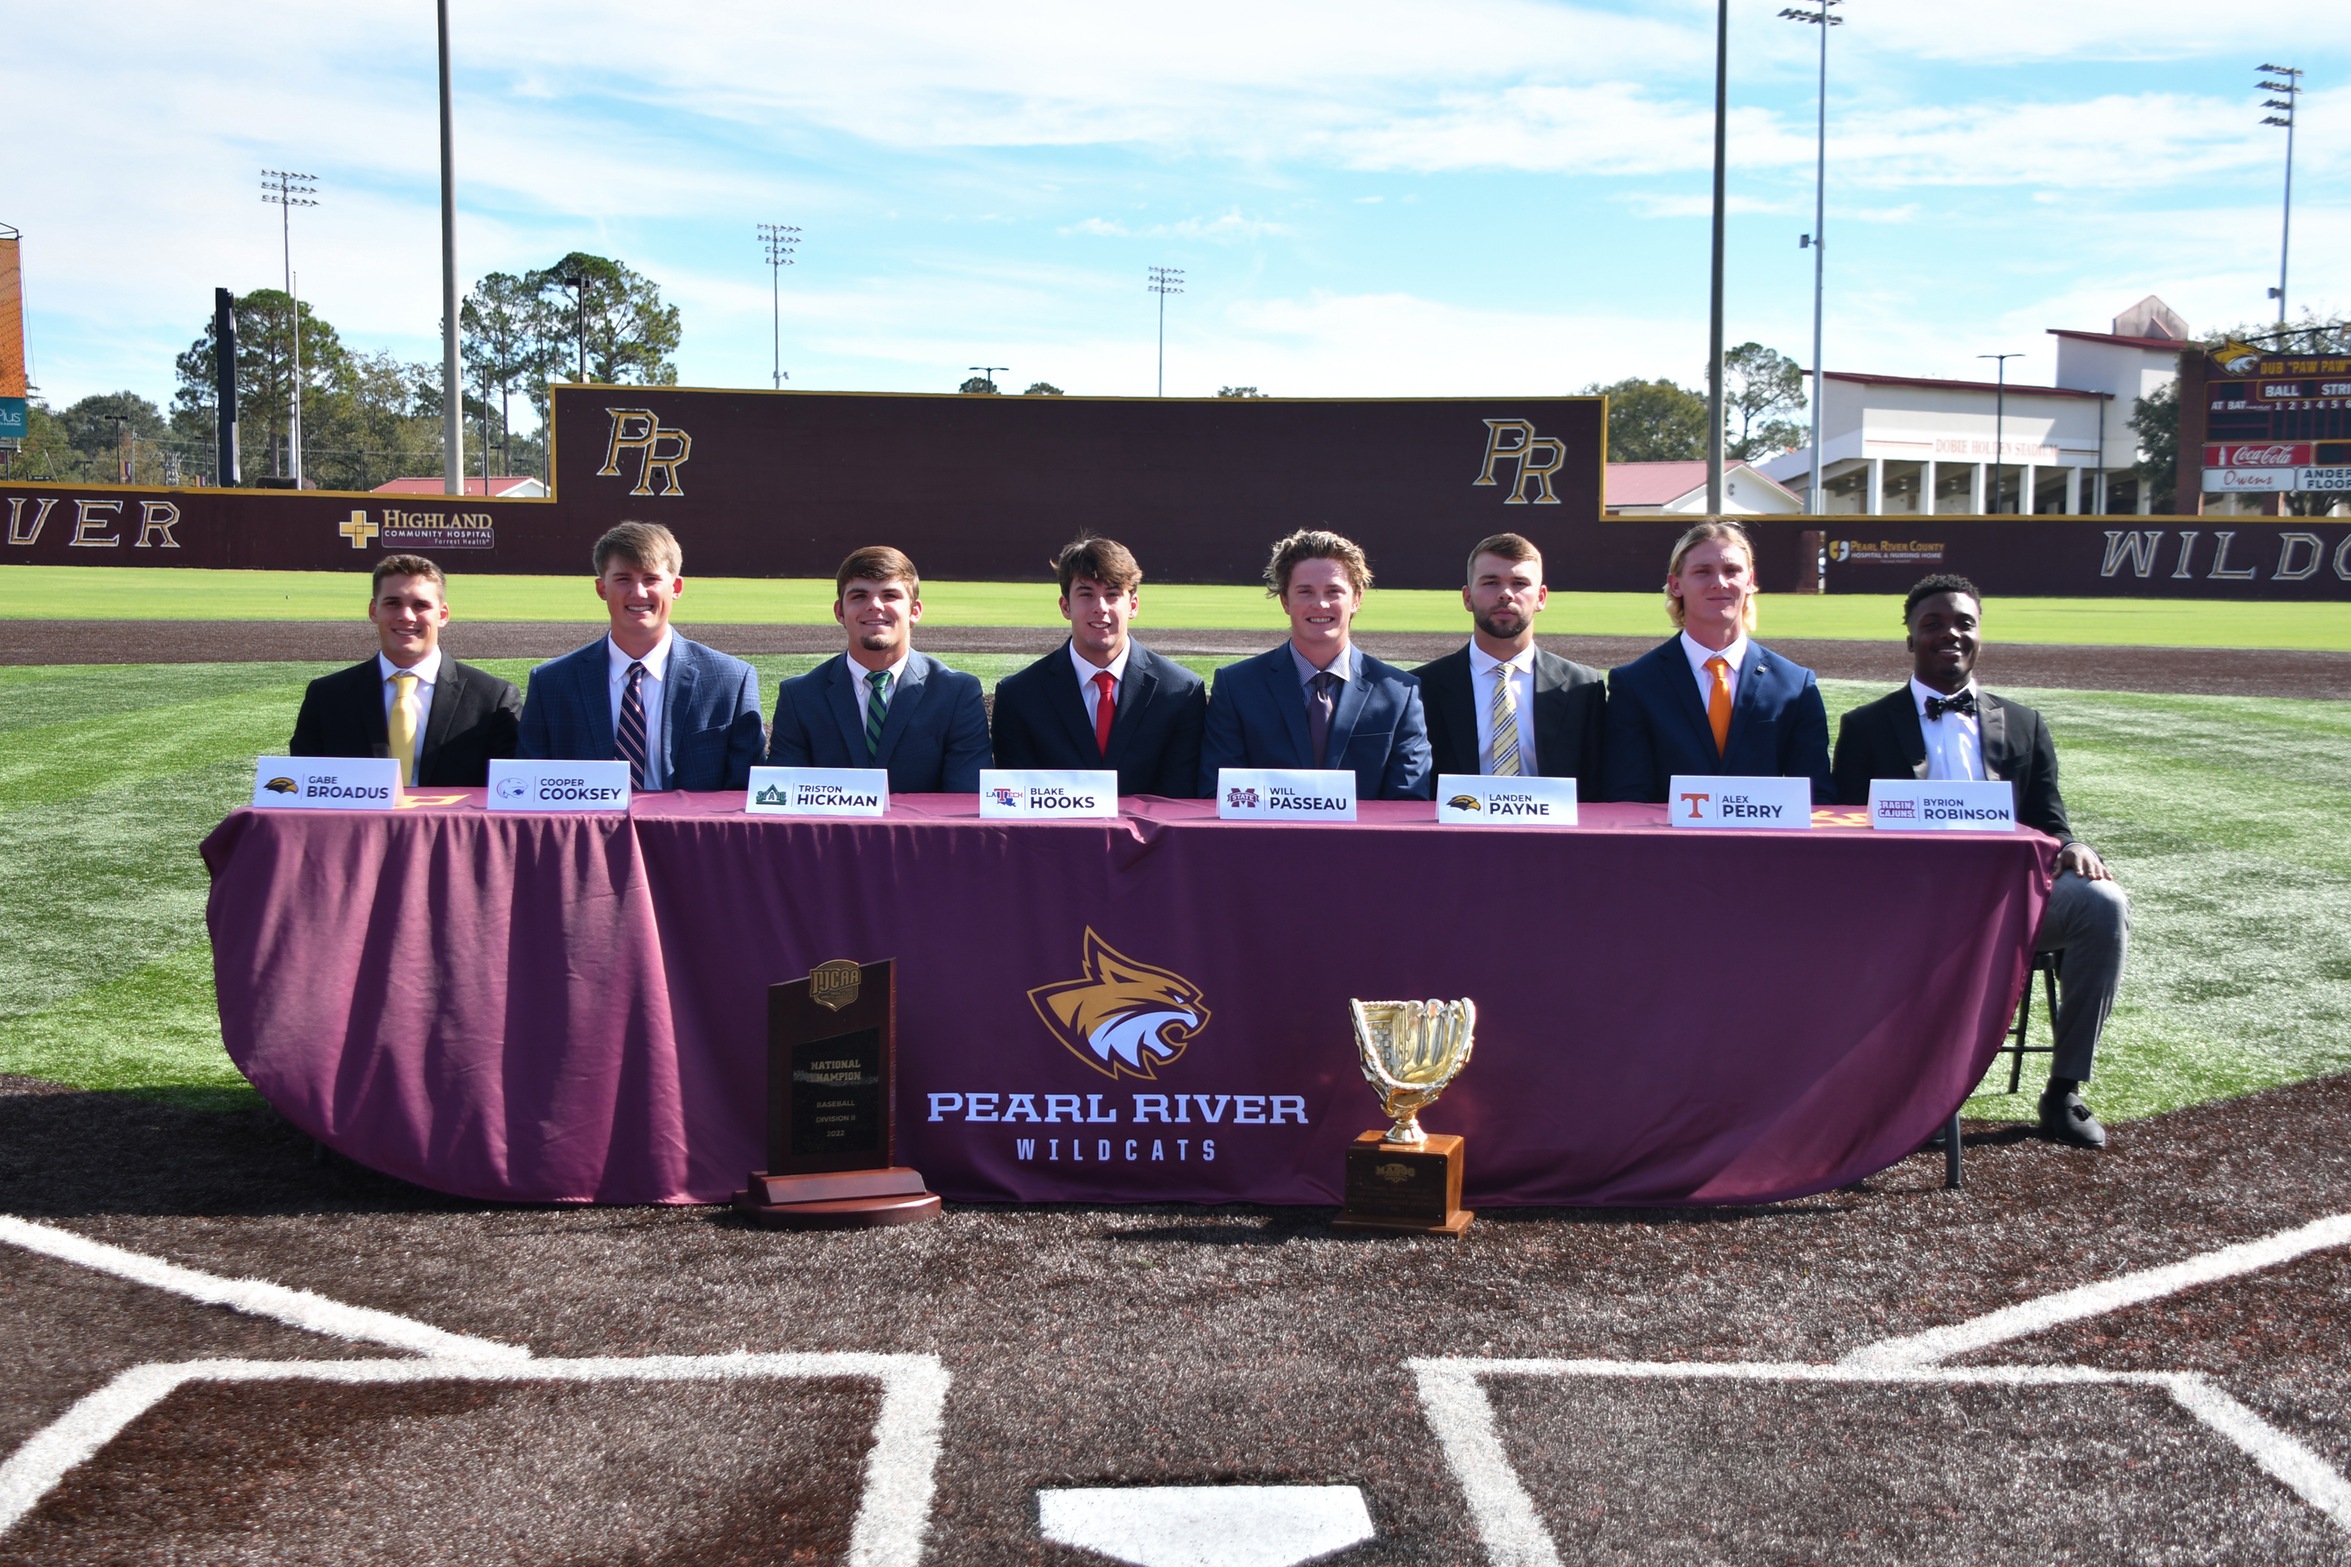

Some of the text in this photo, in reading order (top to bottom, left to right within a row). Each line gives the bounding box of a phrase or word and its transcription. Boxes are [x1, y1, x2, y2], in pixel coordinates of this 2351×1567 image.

[2260, 362, 2284, 375] DUB
[2264, 385, 2299, 397] BALL
[2210, 401, 2224, 410] AT
[2227, 400, 2247, 410] BAT
[2275, 401, 2283, 410] 1
[2288, 401, 2296, 410] 2
[2302, 401, 2310, 410] 3
[2316, 400, 2325, 409] 4
[2330, 400, 2338, 409] 5
[596, 408, 692, 496] PR
[1936, 439, 1968, 454] DOBIE
[1472, 419, 1567, 504] PR
[2223, 470, 2273, 485] Owens
[7, 498, 181, 548] VER
[382, 509, 493, 529] HIGHLAND
[384, 530, 443, 538] COMMUNITY
[1850, 540, 1945, 551] PEARL RIVER COUNTY
[308, 775, 338, 784] GABE
[540, 778, 585, 787] COOPER
[307, 785, 389, 799] BROADUS
[539, 787, 622, 801] COOKSEY
[798, 784, 843, 794] TRISTON
[1030, 787, 1065, 796] BLAKE
[1269, 787, 1296, 796] WILL
[797, 794, 878, 807] HICKMAN
[1030, 796, 1095, 809] HOOKS
[1232, 793, 1255, 801] STATE
[1489, 793, 1533, 803] LANDEN
[1722, 795, 1749, 804] ALEX
[1923, 798, 1964, 807] BYRION
[1269, 797, 1347, 810] PASSEAU
[1489, 802, 1550, 816] PAYNE
[1722, 804, 1782, 819] PERRY
[1879, 809, 1913, 818] CAJUNS
[1924, 808, 2009, 821] ROBINSON
[811, 969, 860, 995] NJCAA
[811, 1059, 861, 1071] NATIONAL
[811, 1071, 861, 1083] CHAMPION
[816, 1100, 855, 1108] BASEBALL
[927, 1092, 1309, 1124] PEARL RIVER
[815, 1115, 849, 1123] DIVISION
[1016, 1138, 1215, 1161] WILDCATS
